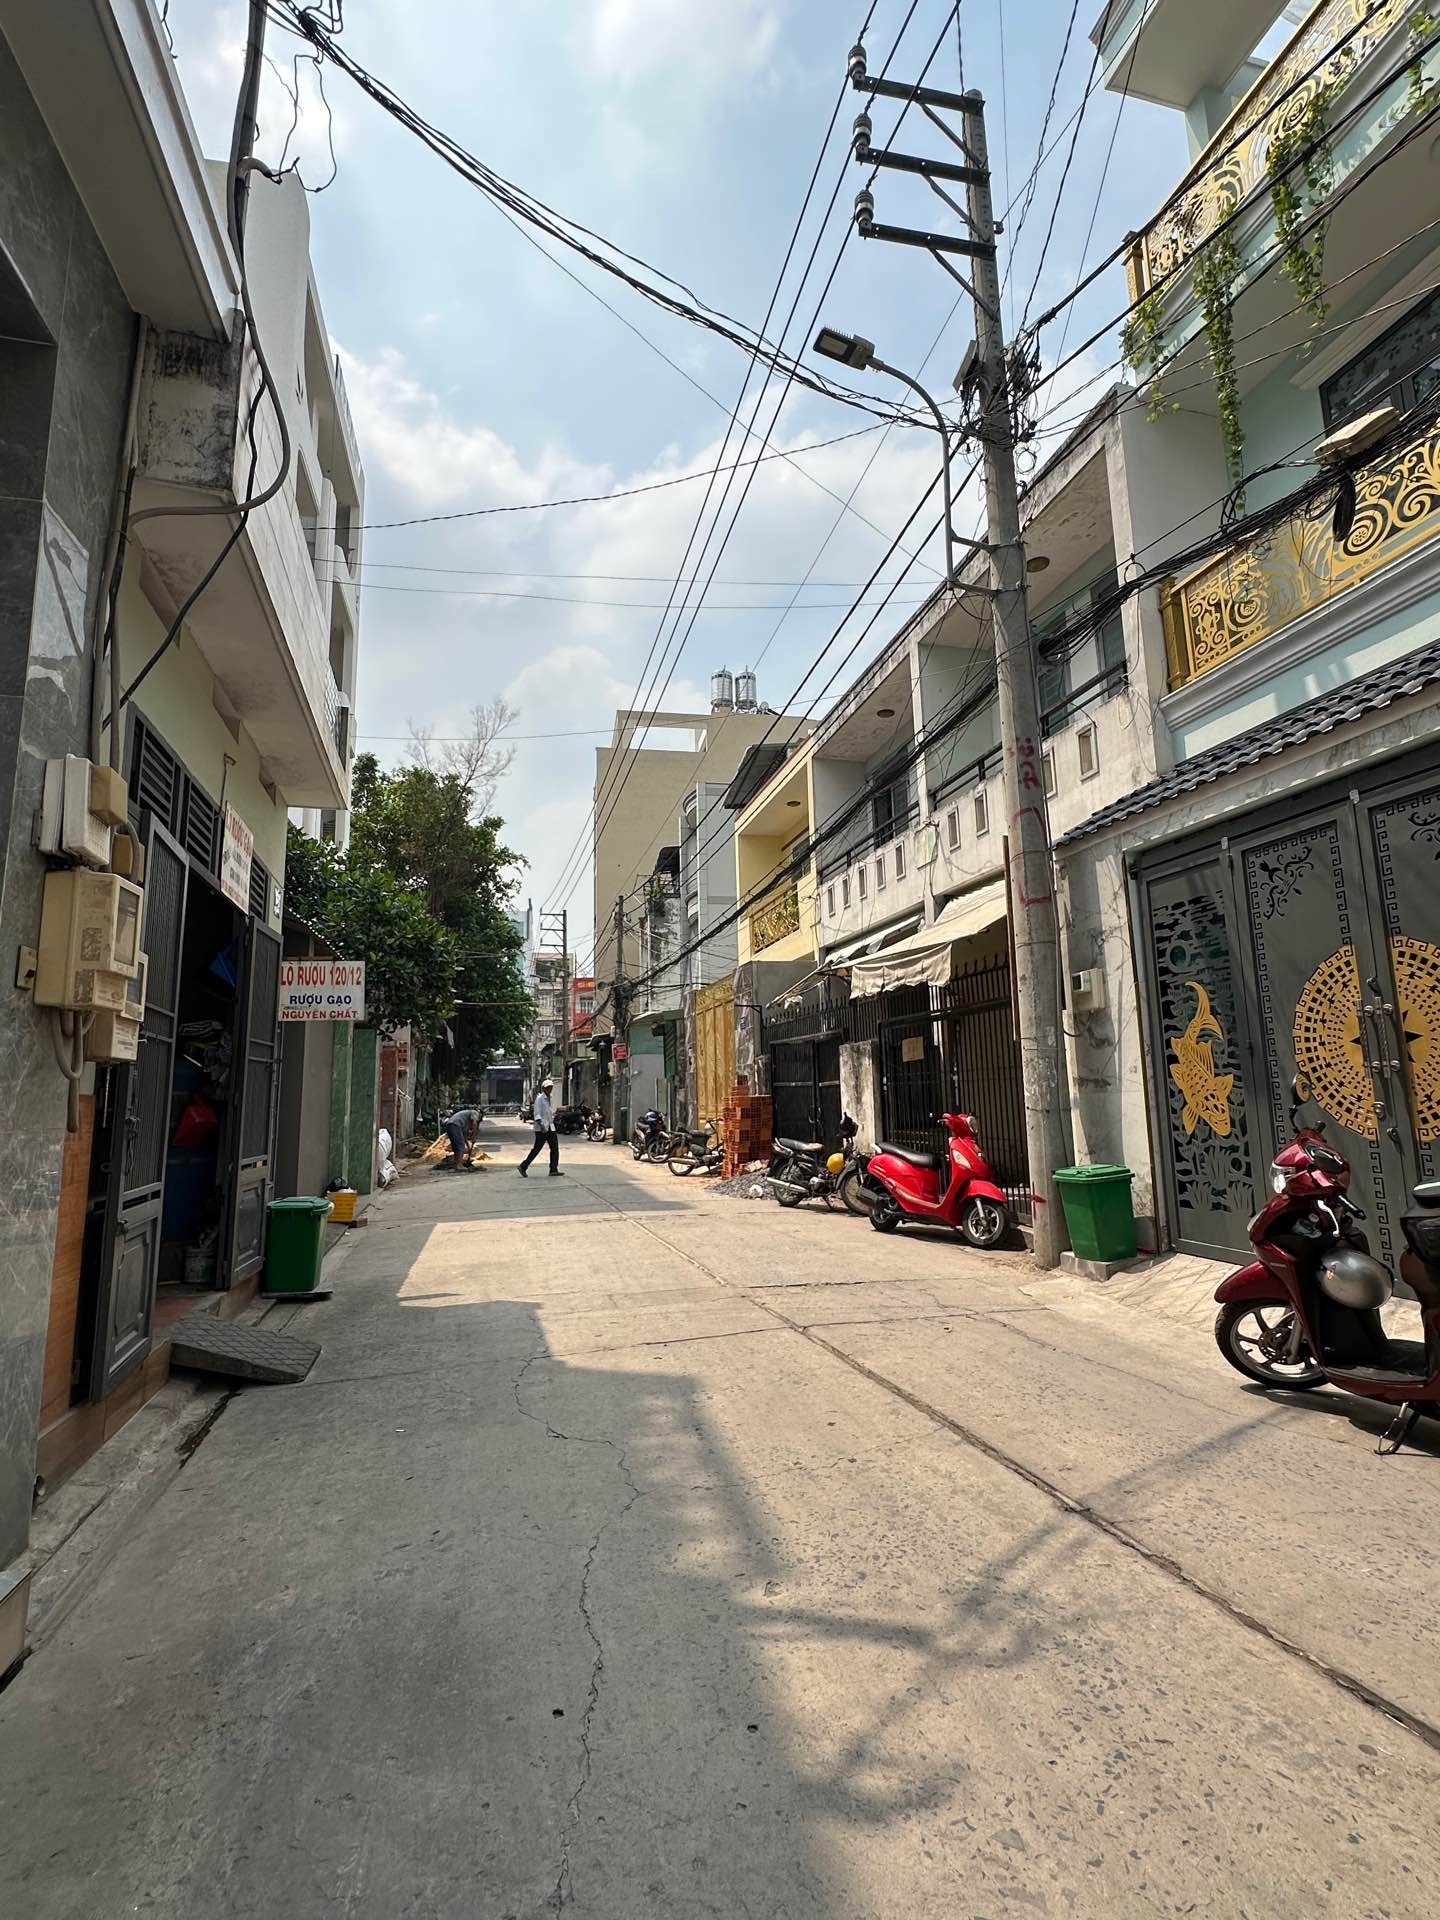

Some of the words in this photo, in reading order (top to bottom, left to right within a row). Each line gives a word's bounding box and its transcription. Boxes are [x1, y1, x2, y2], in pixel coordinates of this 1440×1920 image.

[281, 962, 294, 986] LÒ
[297, 962, 326, 988] RƯỢU
[330, 966, 362, 987] 120/12
[289, 993, 323, 1008] RƯỢU
[326, 995, 352, 1007] GẠO
[282, 1008, 327, 1019] NGUYÊN
